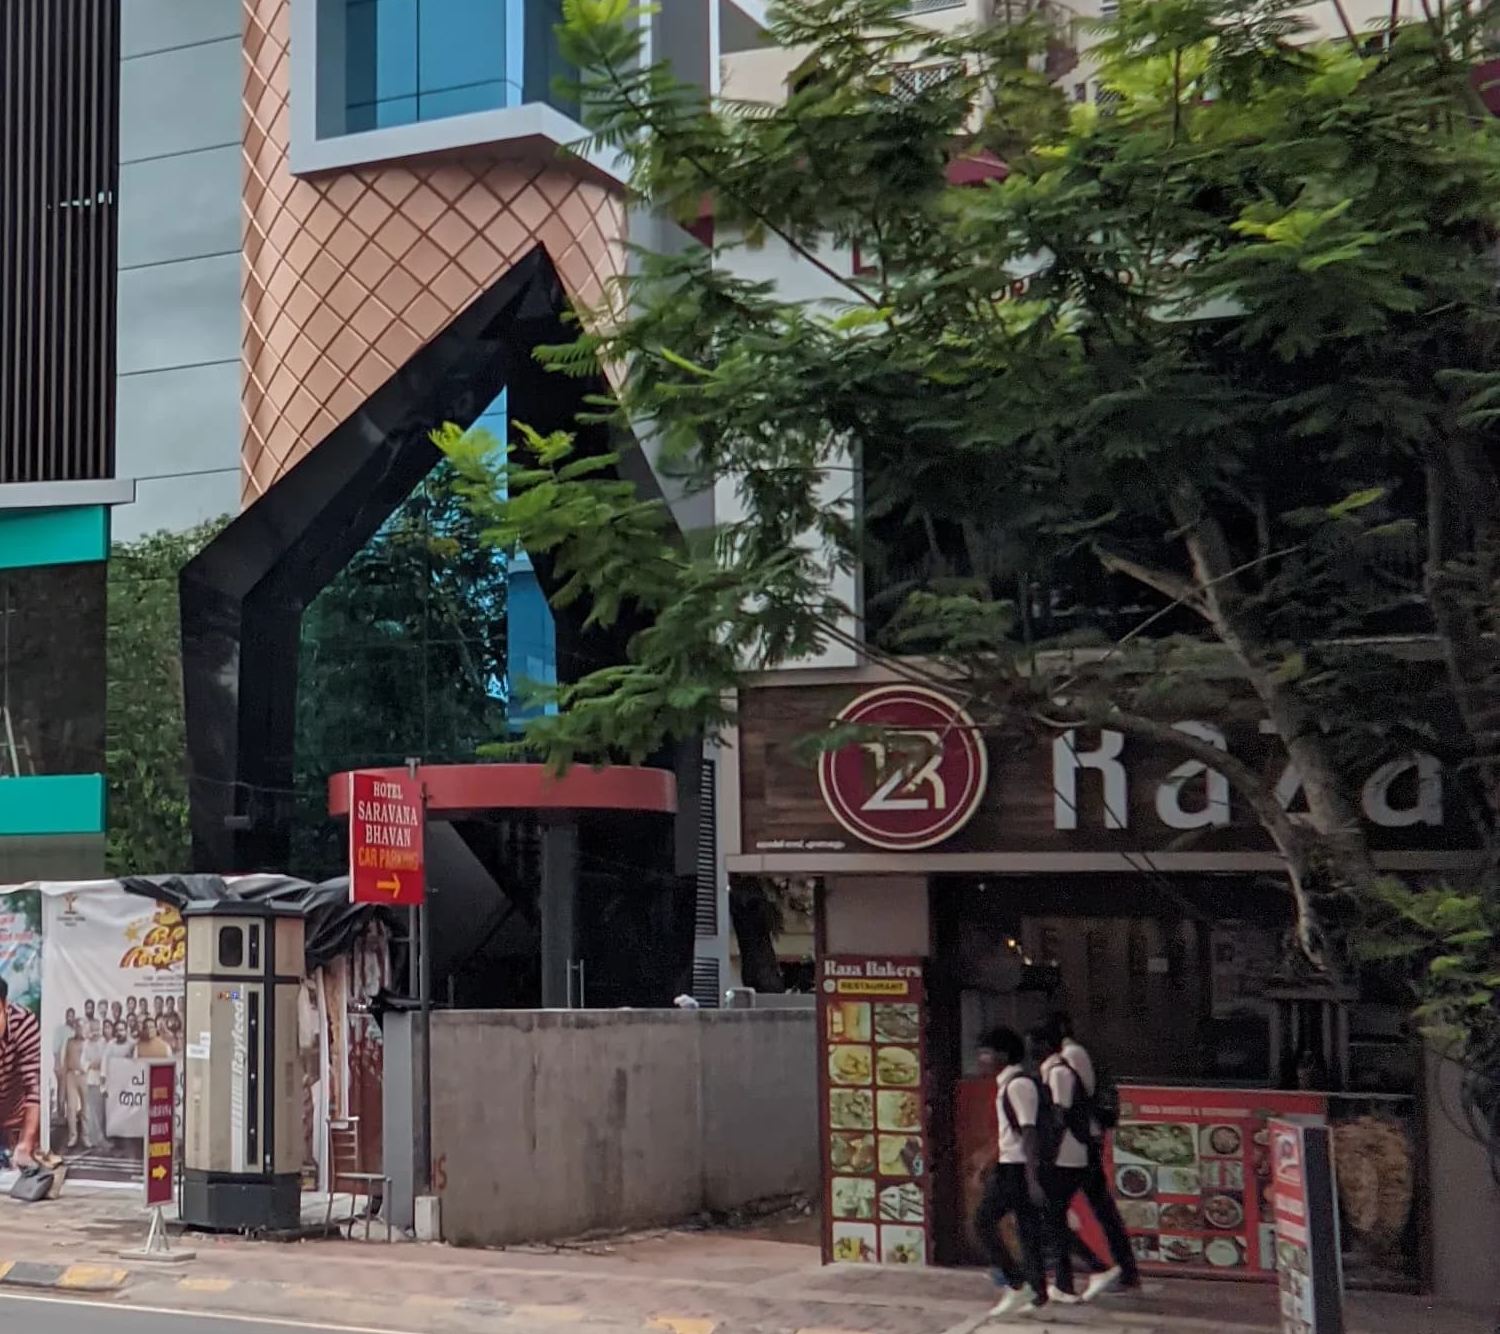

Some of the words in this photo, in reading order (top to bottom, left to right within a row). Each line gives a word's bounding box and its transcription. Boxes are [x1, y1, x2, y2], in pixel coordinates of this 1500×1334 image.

[373, 780, 403, 800] HOTEL
[357, 799, 419, 827] SARAVANA
[365, 823, 412, 848] BHAVAN
[358, 847, 378, 868] CAR
[379, 849, 420, 872] PARKING
[824, 959, 862, 976] Raza
[864, 960, 923, 978] Bakers
